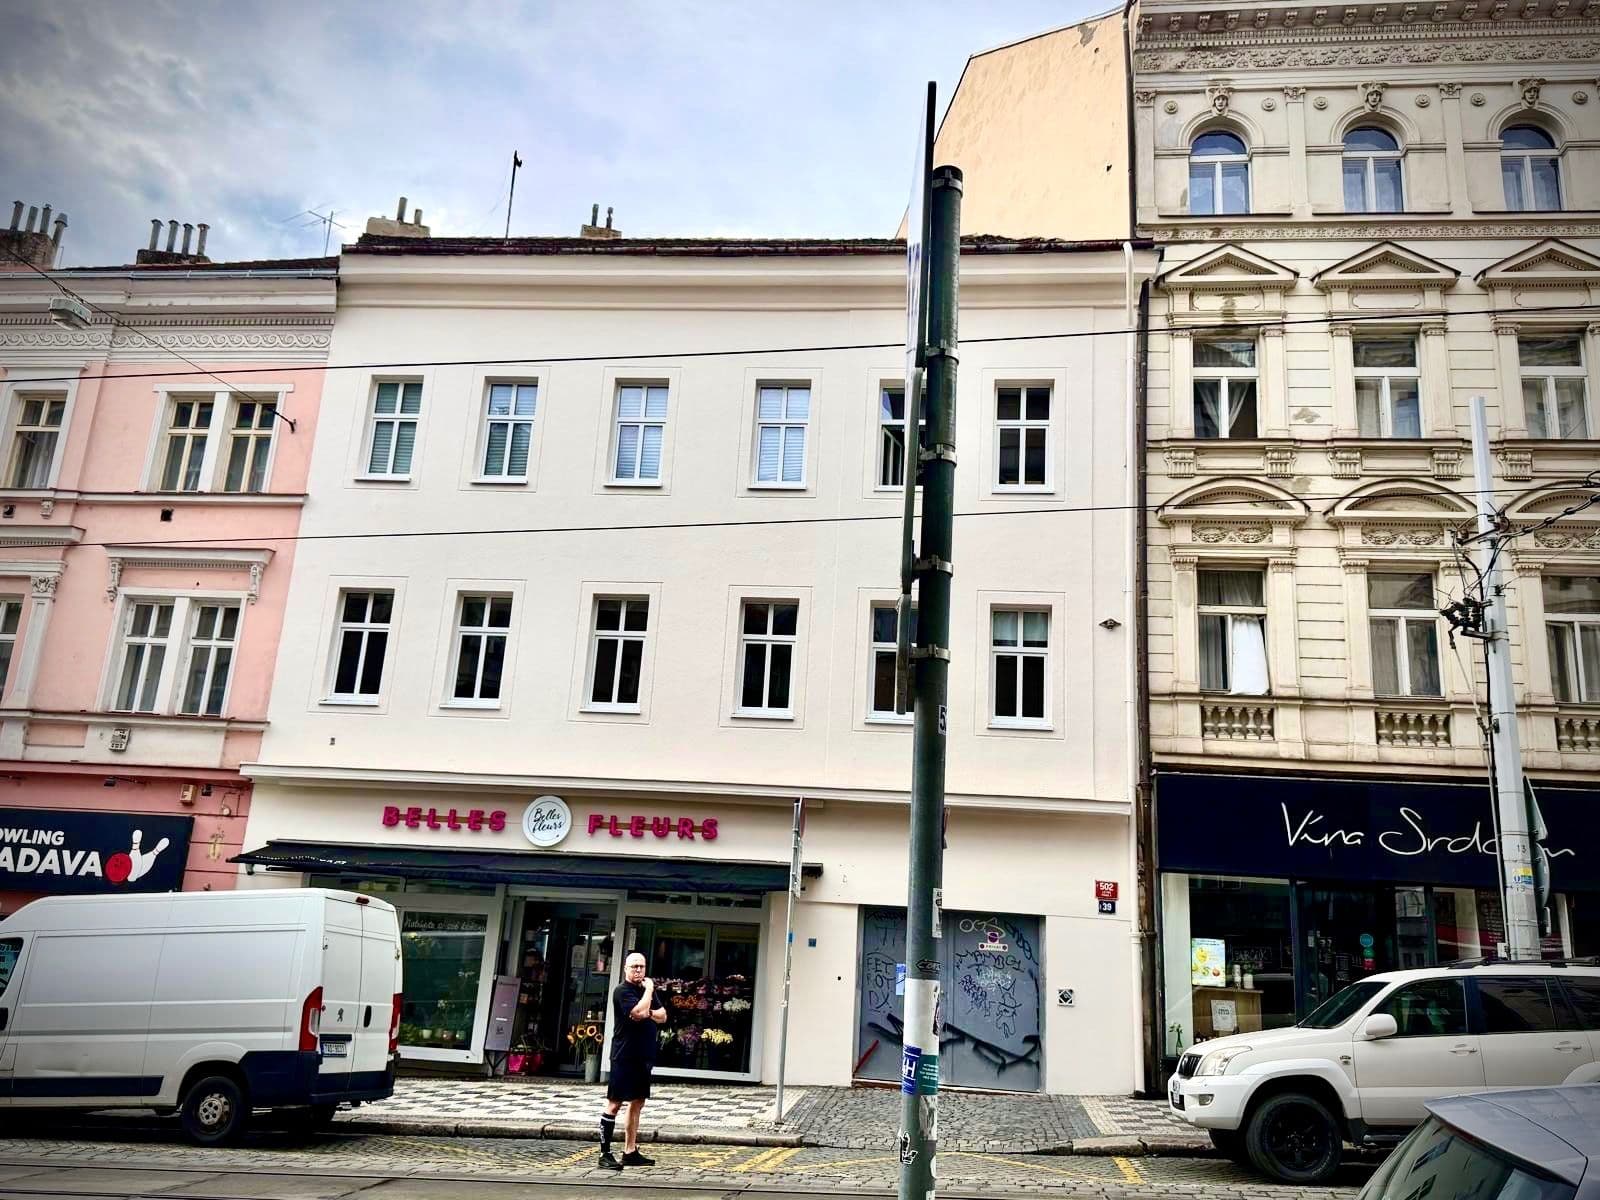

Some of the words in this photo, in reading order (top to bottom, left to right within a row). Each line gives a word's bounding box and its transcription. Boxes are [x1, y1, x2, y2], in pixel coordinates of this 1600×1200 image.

[383, 806, 507, 832] BELLES
[588, 814, 719, 840] FLEURS
[533, 808, 562, 823] Belles
[1281, 802, 1364, 846] Vína
[1099, 882, 1114, 891] 502
[1102, 902, 1112, 911] 39
